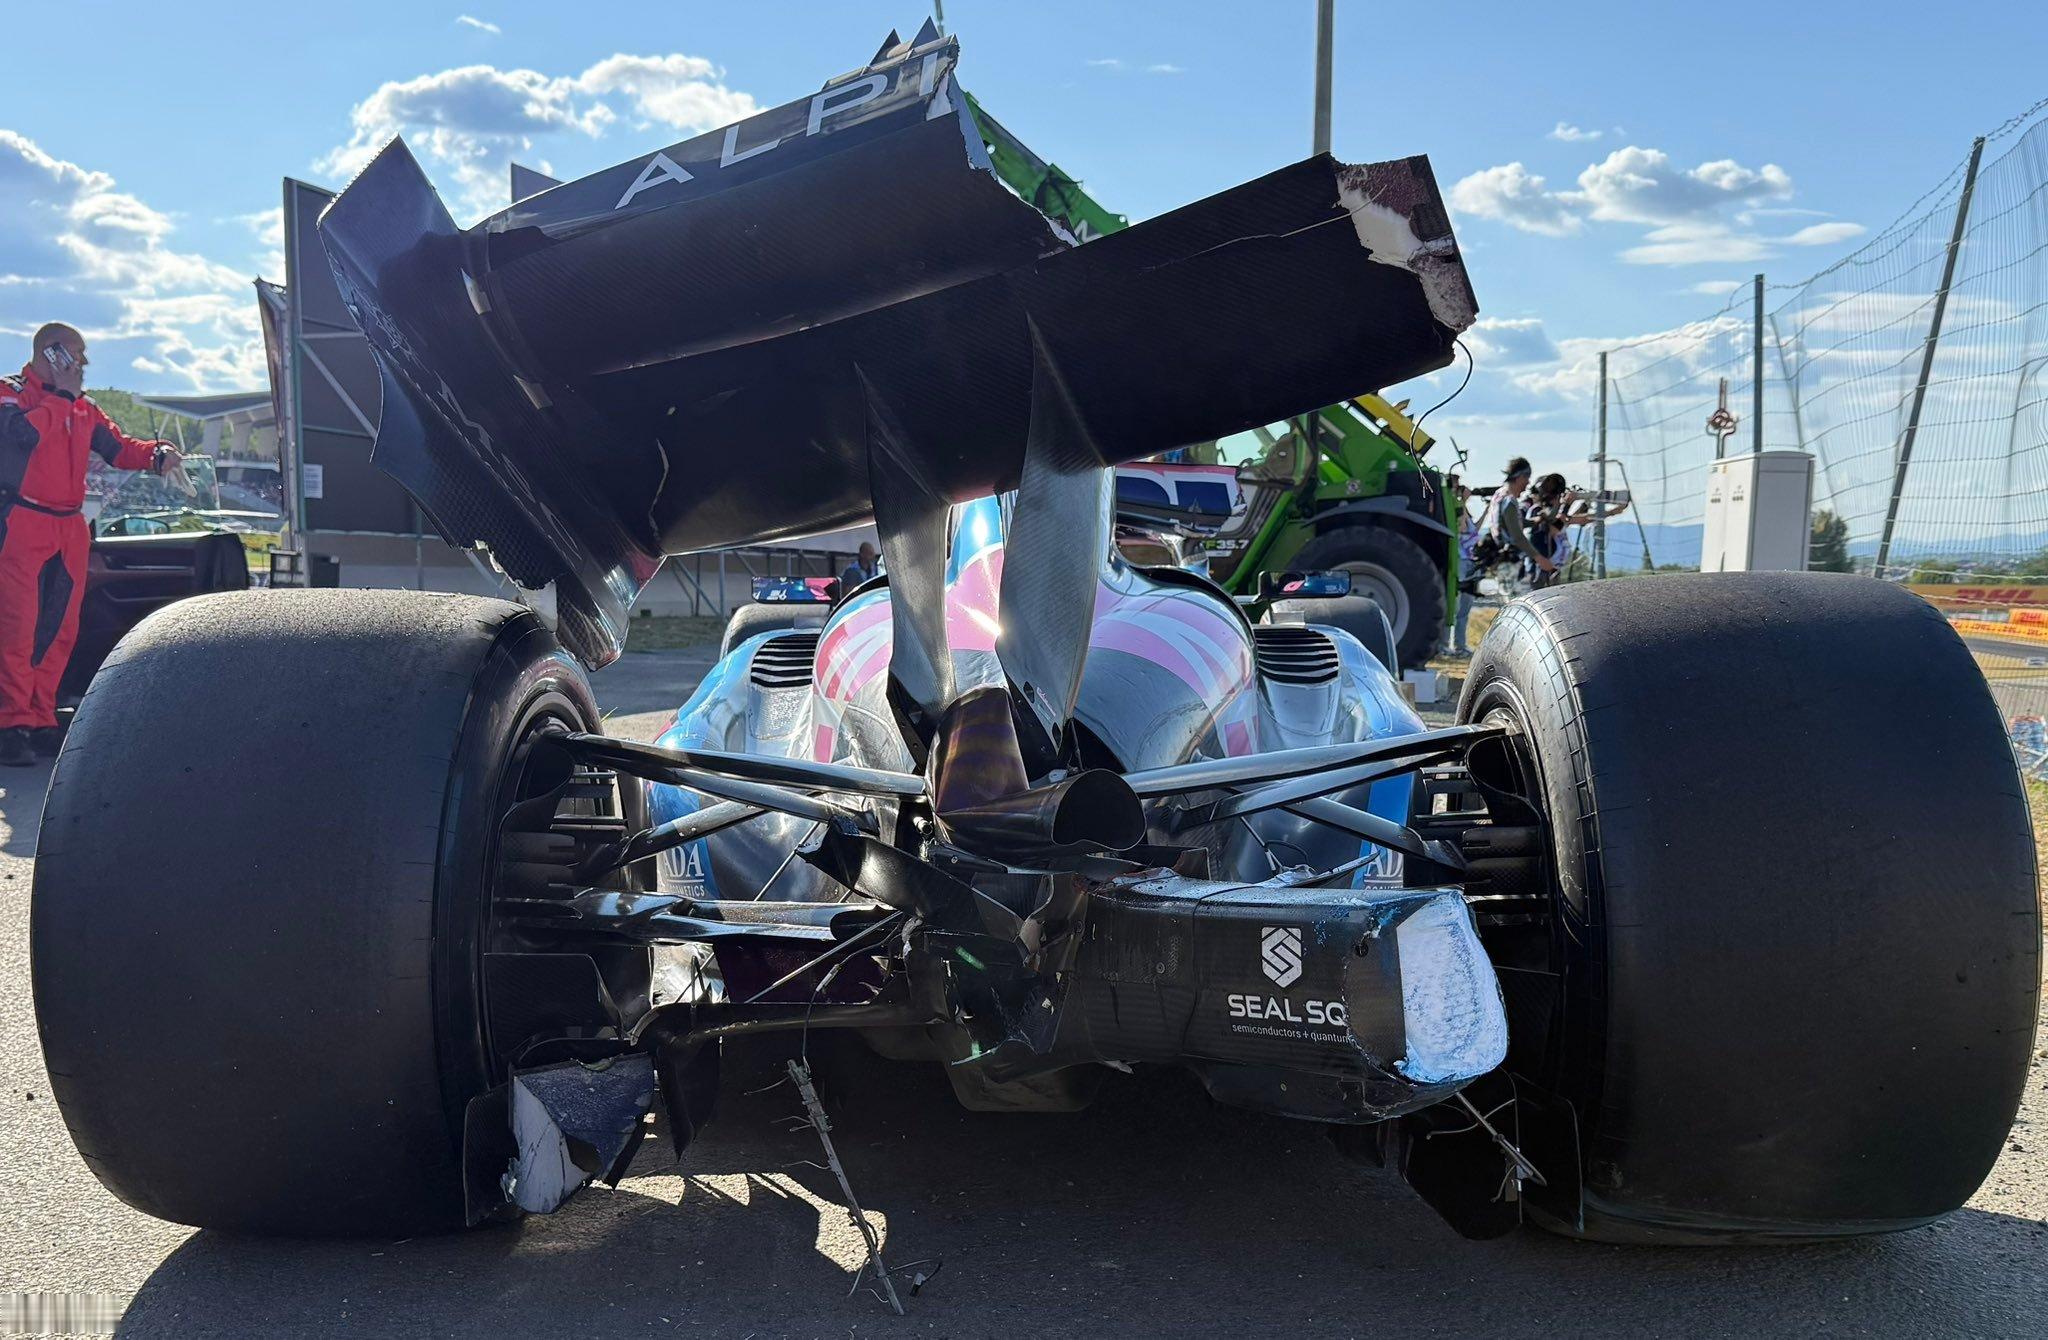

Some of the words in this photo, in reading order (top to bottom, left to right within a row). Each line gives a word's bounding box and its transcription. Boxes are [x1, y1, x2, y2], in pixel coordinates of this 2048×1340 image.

[1956, 588, 2034, 599] DHL
[1227, 994, 1302, 1022] SEAL
[1305, 1000, 1348, 1027] SQ
[1232, 1024, 1301, 1039] semiconductors
